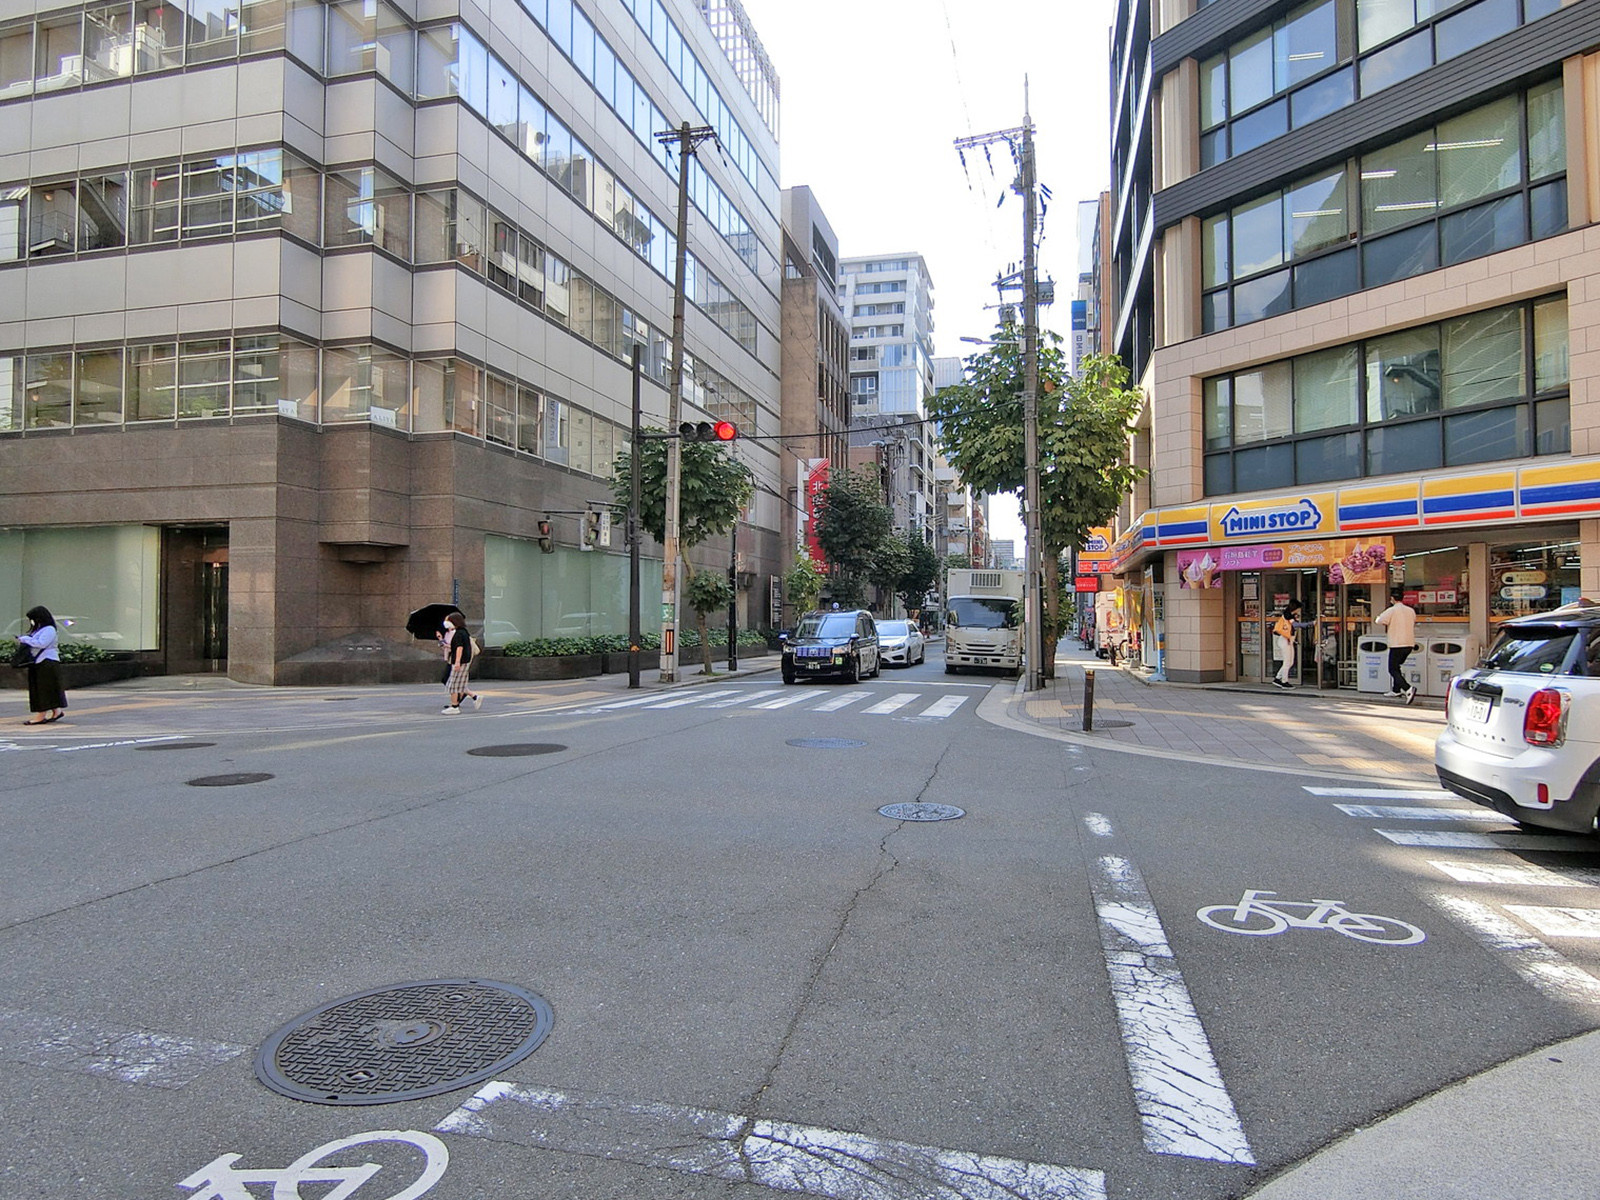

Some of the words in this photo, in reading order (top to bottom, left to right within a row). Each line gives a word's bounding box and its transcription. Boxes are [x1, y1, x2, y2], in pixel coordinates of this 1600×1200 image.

[1229, 514, 1265, 531] MINI
[1268, 510, 1311, 528] STOP
[1224, 559, 1240, 567] ソフト
